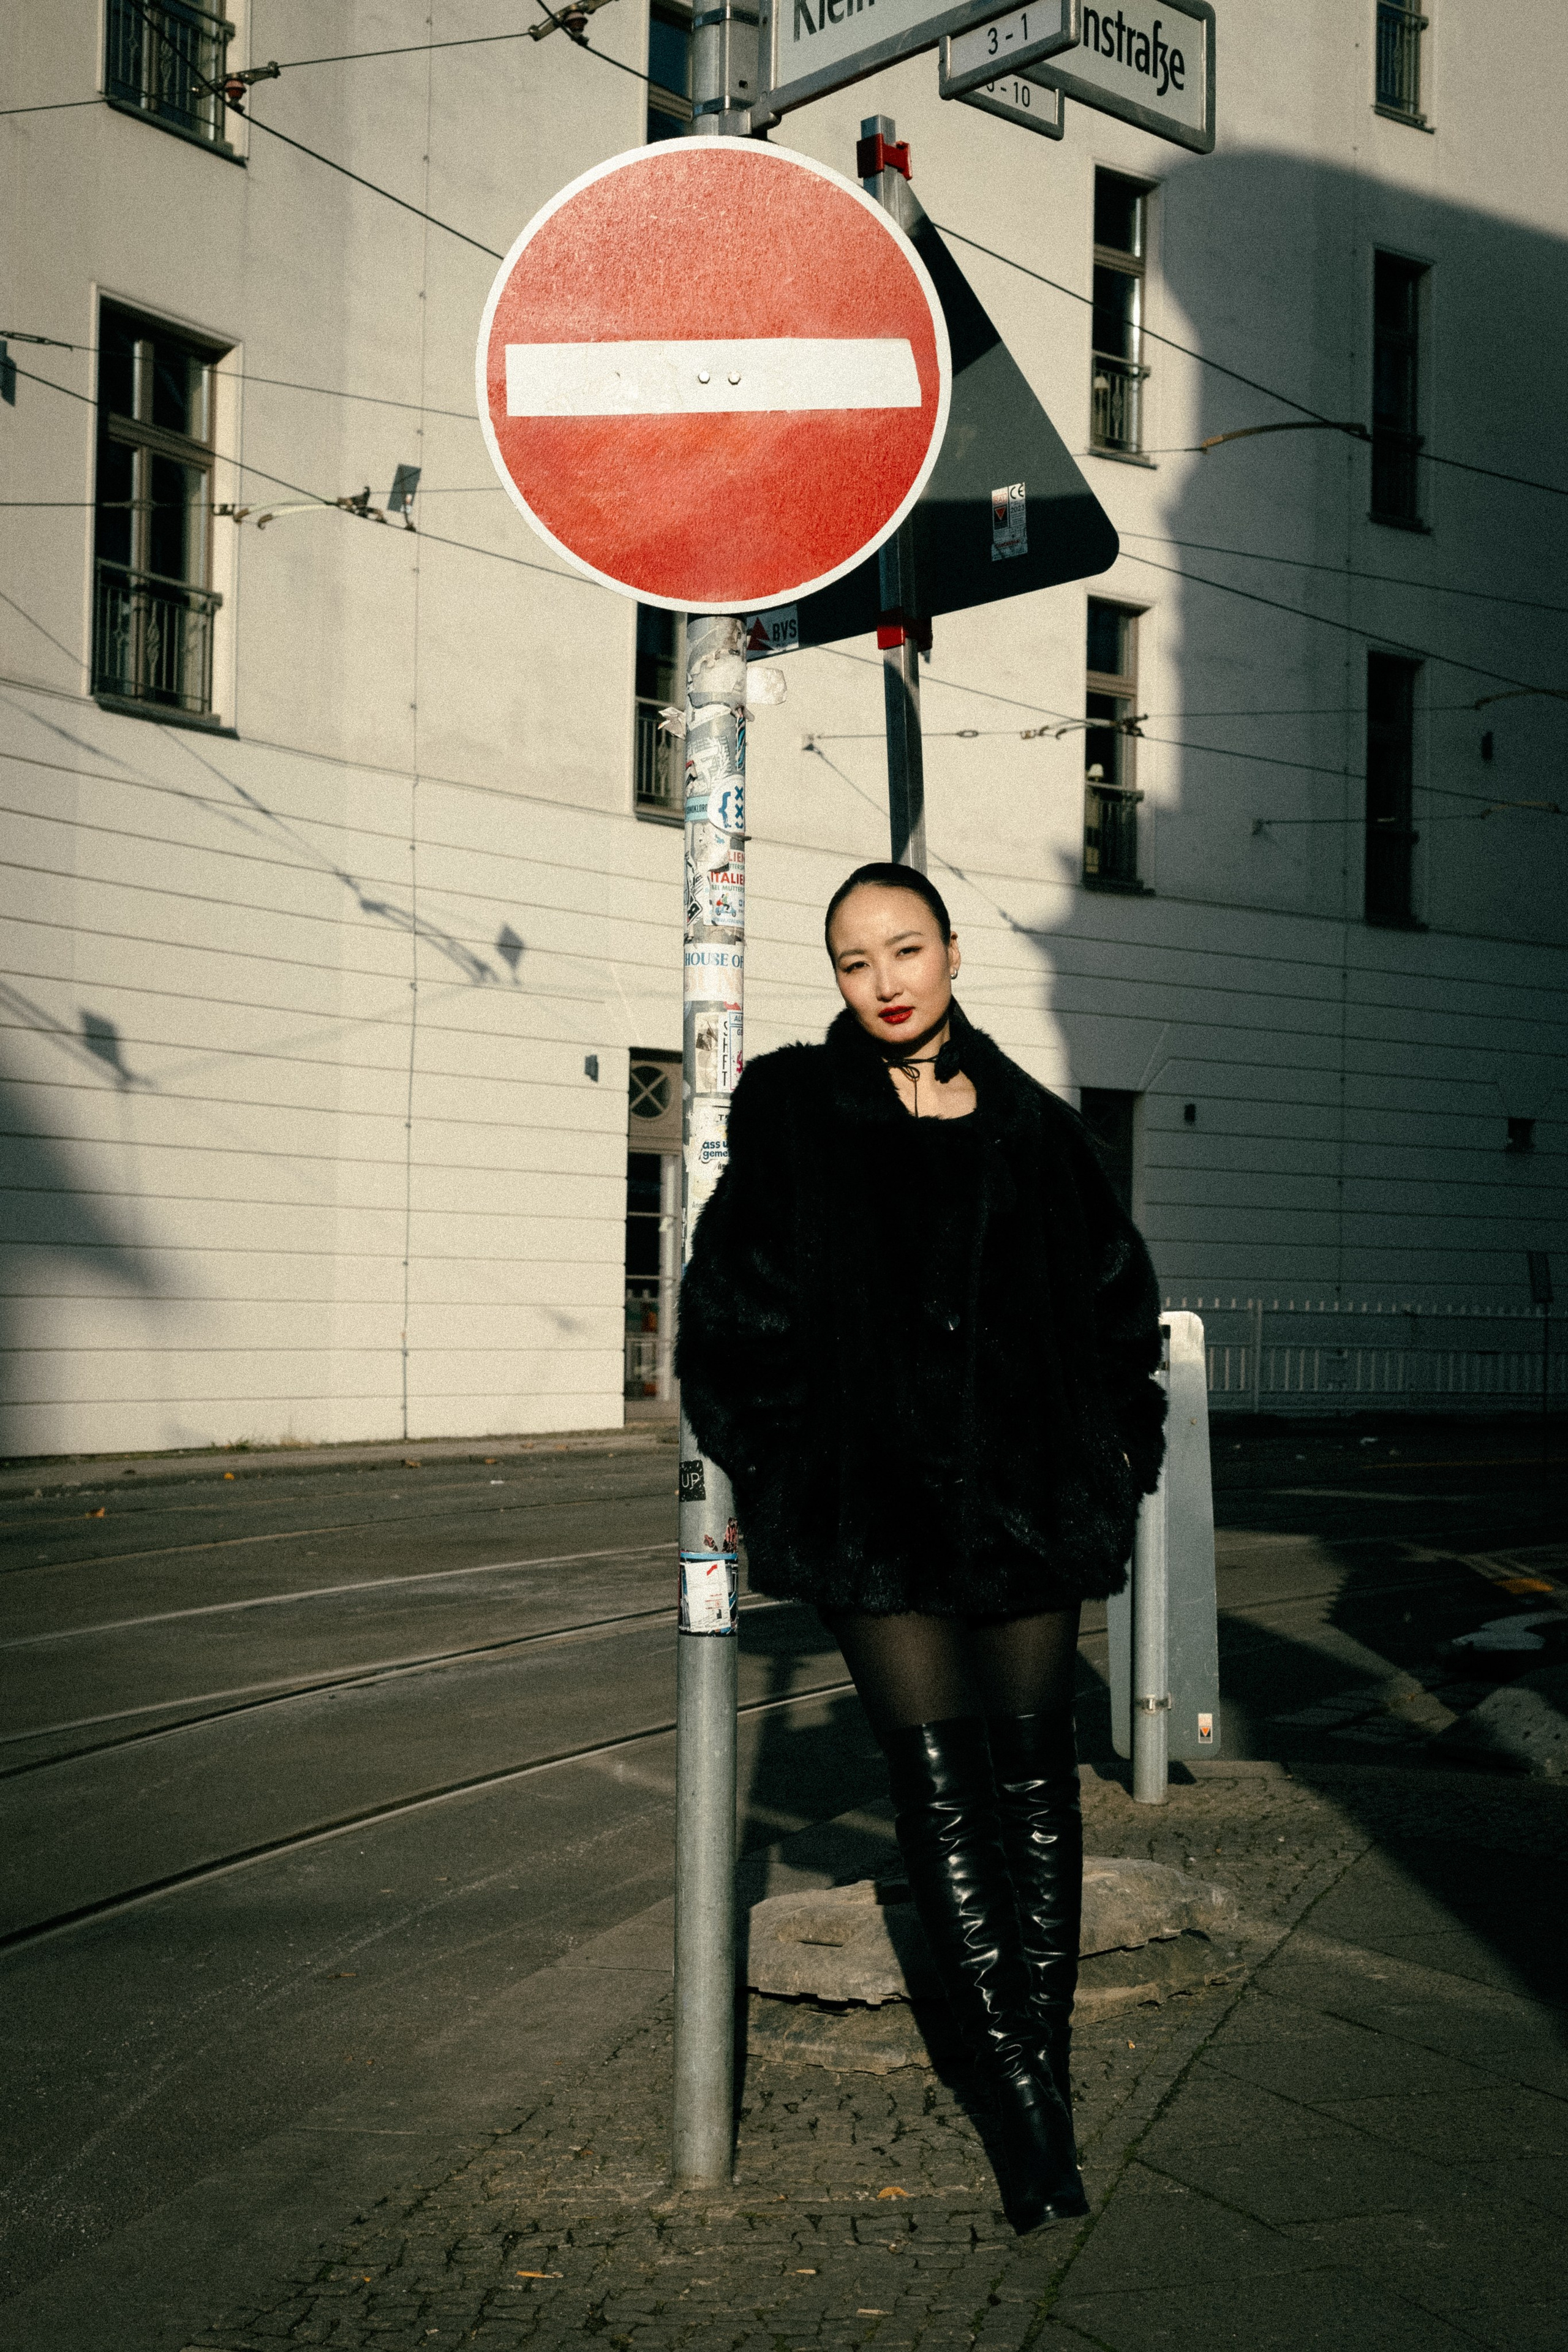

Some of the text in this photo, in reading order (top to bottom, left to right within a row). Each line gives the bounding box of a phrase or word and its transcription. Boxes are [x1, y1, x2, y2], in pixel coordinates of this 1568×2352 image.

[1014, 81, 1030, 107] 10
[772, 619, 797, 642] BVS
[685, 952, 728, 966] HOUSE
